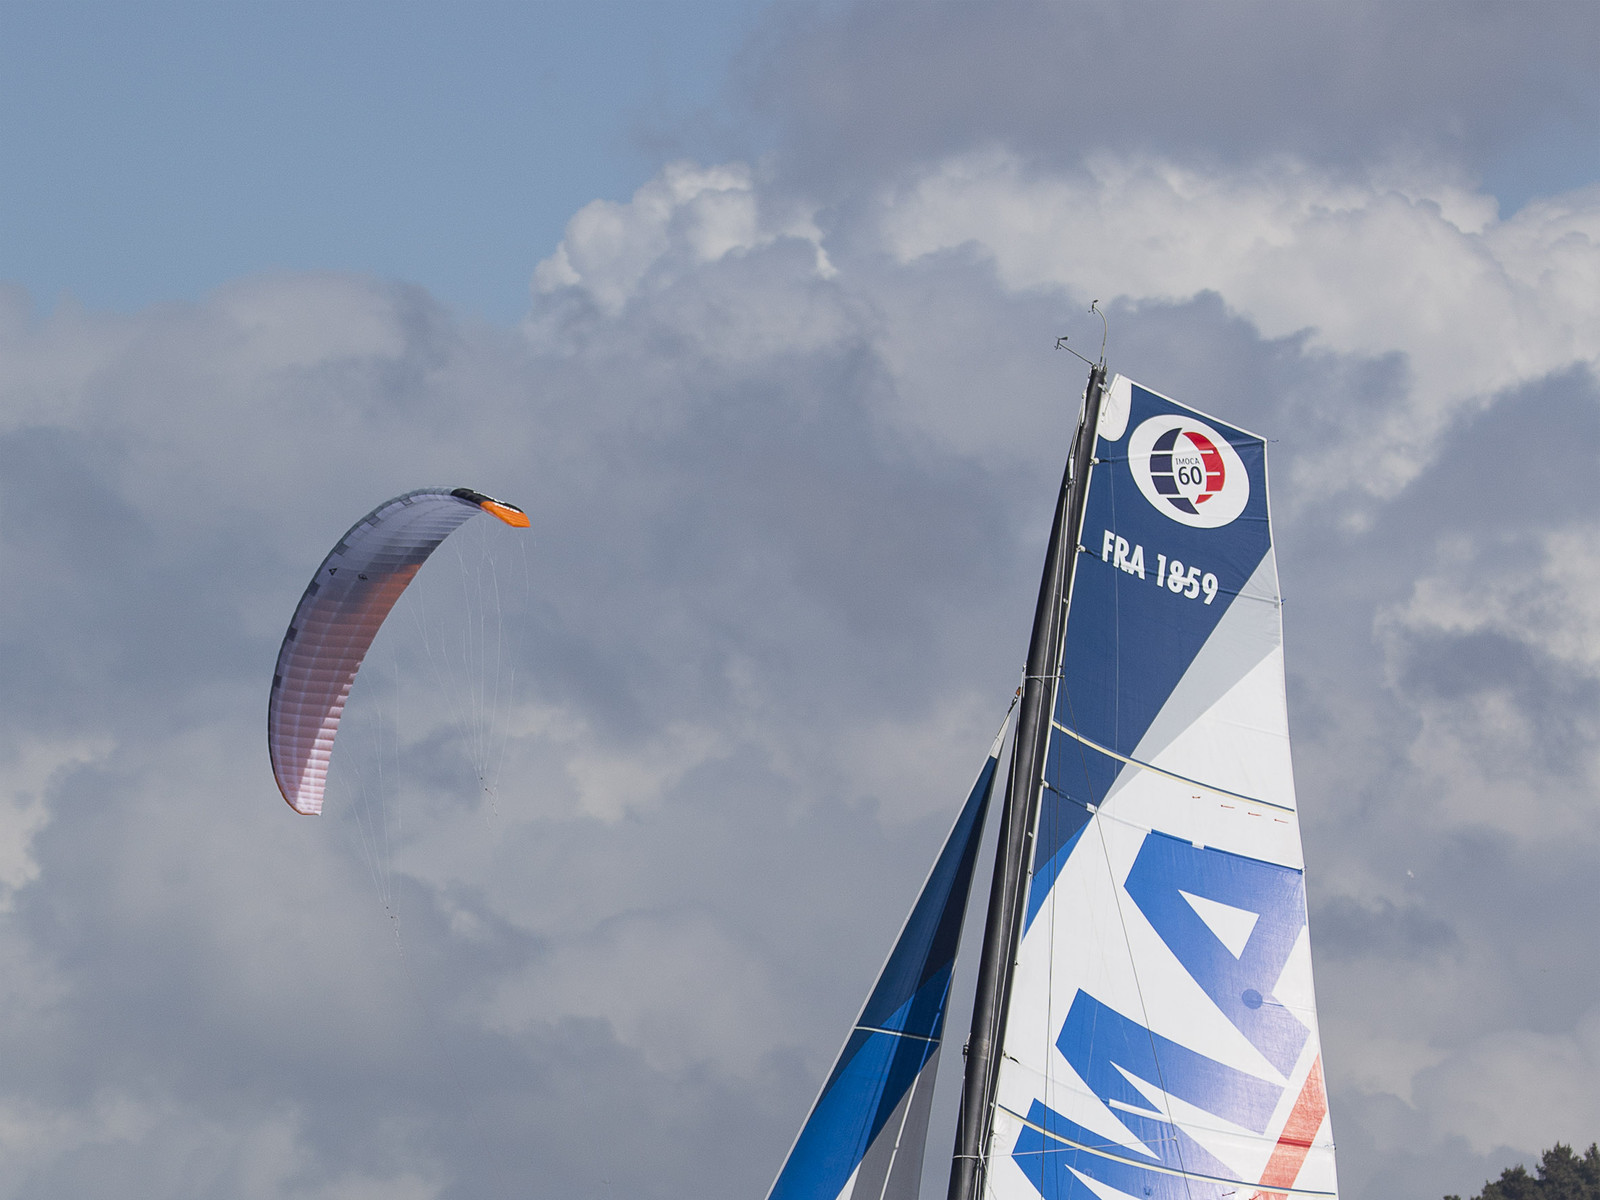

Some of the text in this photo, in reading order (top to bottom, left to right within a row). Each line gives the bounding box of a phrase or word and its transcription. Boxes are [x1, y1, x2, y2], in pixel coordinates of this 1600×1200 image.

[1175, 457, 1201, 465] IMOCA
[1178, 465, 1203, 486] 60
[1101, 529, 1219, 606] FRA 1859
